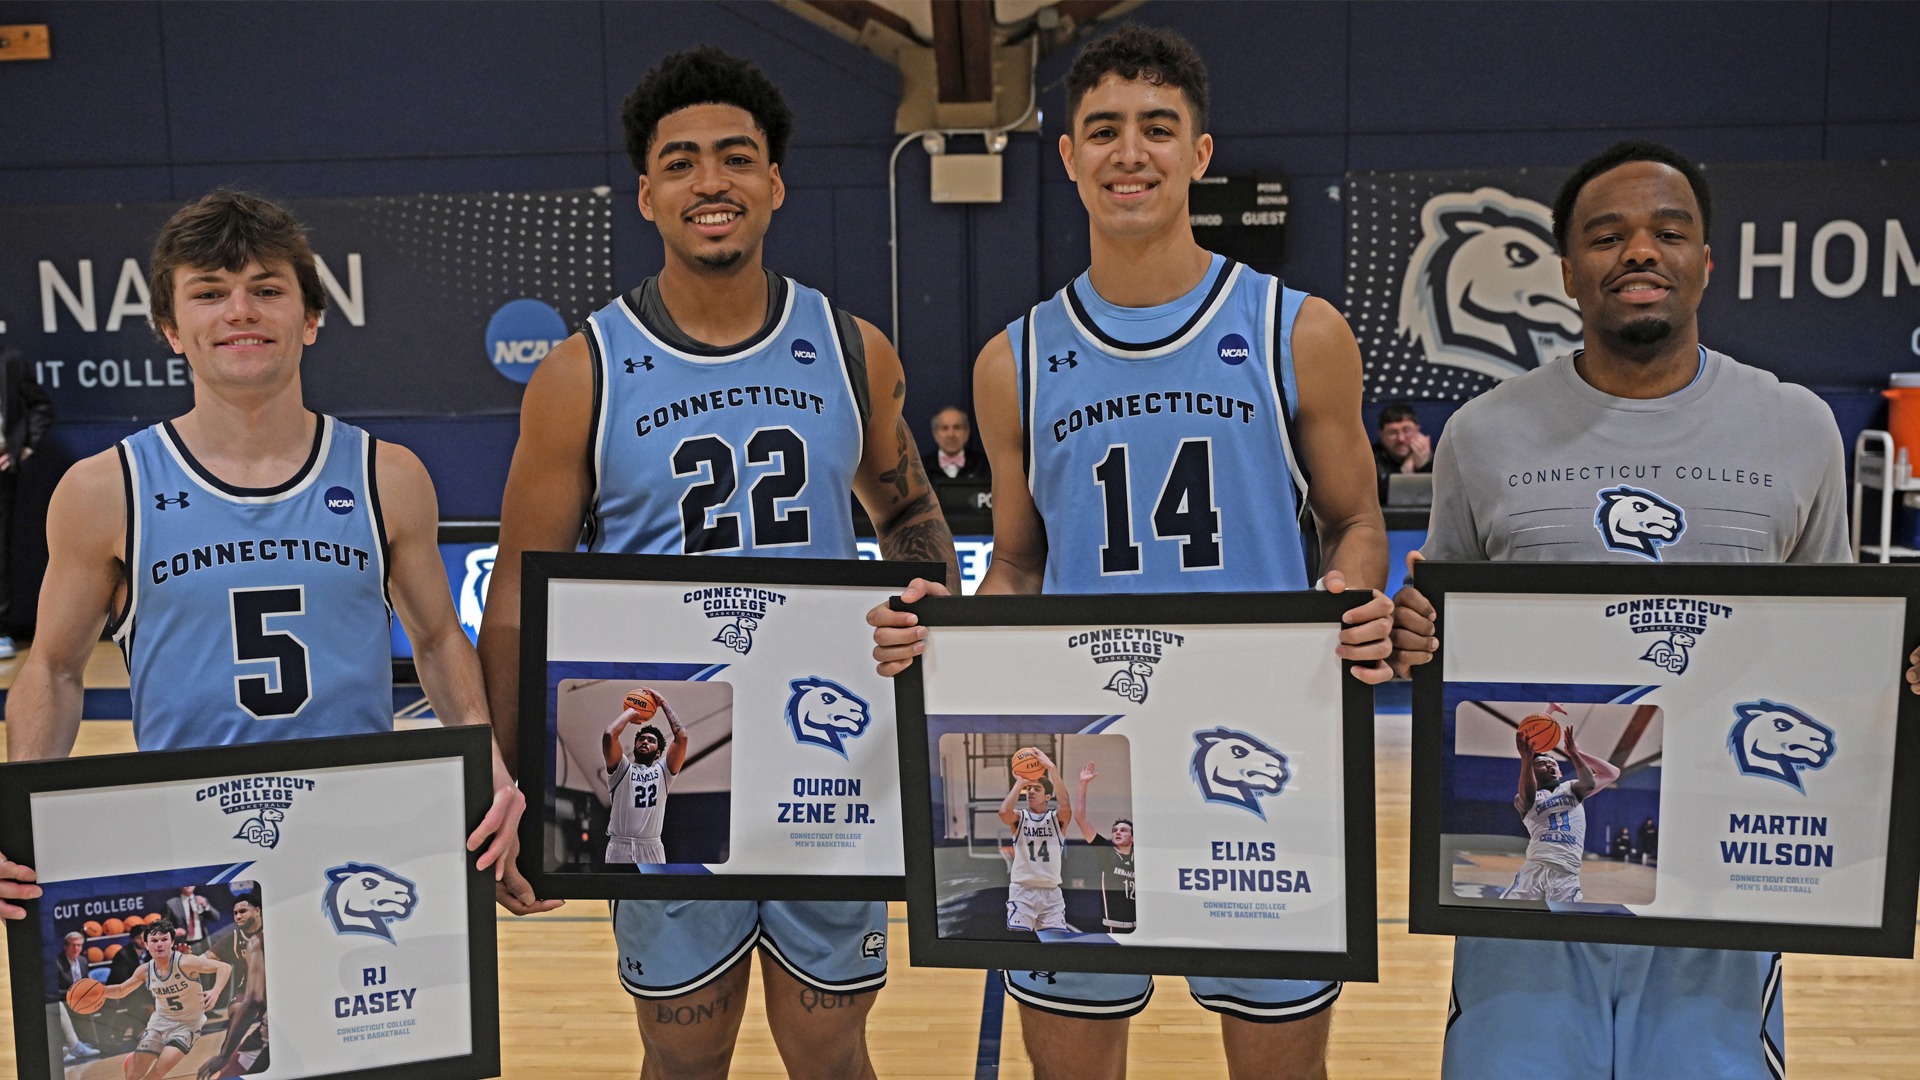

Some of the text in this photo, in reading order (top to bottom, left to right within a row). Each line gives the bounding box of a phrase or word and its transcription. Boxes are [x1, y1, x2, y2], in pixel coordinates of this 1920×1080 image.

[1242, 211, 1287, 225] GUEST
[494, 340, 563, 364] NCA
[794, 350, 817, 360] NCAA
[1220, 348, 1249, 359] NCAA
[635, 386, 825, 438] CONNECTICUT
[1052, 391, 1255, 443] CONNECTICUT
[1508, 465, 1773, 488] CONNECTICUT COLLEGE
[669, 425, 811, 555] 22
[326, 498, 355, 508] NCAA
[1092, 437, 1224, 576] 14
[151, 538, 370, 585] CONNECTICUT
[684, 587, 786, 606] CONNECTICUT
[703, 598, 766, 612] COLLEGE
[709, 610, 761, 618] BASKETBALL
[1605, 598, 1733, 619] CONNECTICUT
[1629, 611, 1708, 627] COLLEGE
[1637, 625, 1698, 633] BASKETBALL
[1068, 628, 1184, 648] CONNECTICUT
[229, 584, 313, 720] 5
[1091, 641, 1162, 656] COLLEGE
[1098, 655, 1156, 663] BASKETBALL
[195, 777, 315, 802] CONNECTICUT
[634, 783, 658, 808] 22
[793, 778, 861, 797] QURON
[220, 789, 293, 807] COLLEGE
[227, 802, 287, 813] BASKETBALL
[778, 803, 876, 824] ZENE JR.
[1548, 811, 1571, 832] 11
[1023, 826, 1053, 837] CAMELS
[1729, 813, 1828, 837] MARTIN
[1027, 840, 1050, 863] 14
[1211, 841, 1276, 862] ELIAS
[1720, 841, 1834, 867] WILSON
[1178, 868, 1312, 893] ESPINOSA
[1730, 874, 1820, 885] CONNECTICUT COLLEGE
[1736, 883, 1812, 894] MEN'S BASKETBALL
[54, 896, 145, 920] CUT COLLEGE
[1203, 901, 1287, 911] CONNECTICUT COLLEGE
[1234, 911, 1281, 919] BASKETBALL
[363, 966, 386, 987] RJ
[165, 995, 184, 1012] 5
[334, 988, 417, 1019] CASEY
[656, 995, 731, 1026] DON'T
[336, 1018, 416, 1036] CONNECTICUT COLLEGE
[343, 1028, 411, 1043] MEN'S BASKETBALL
